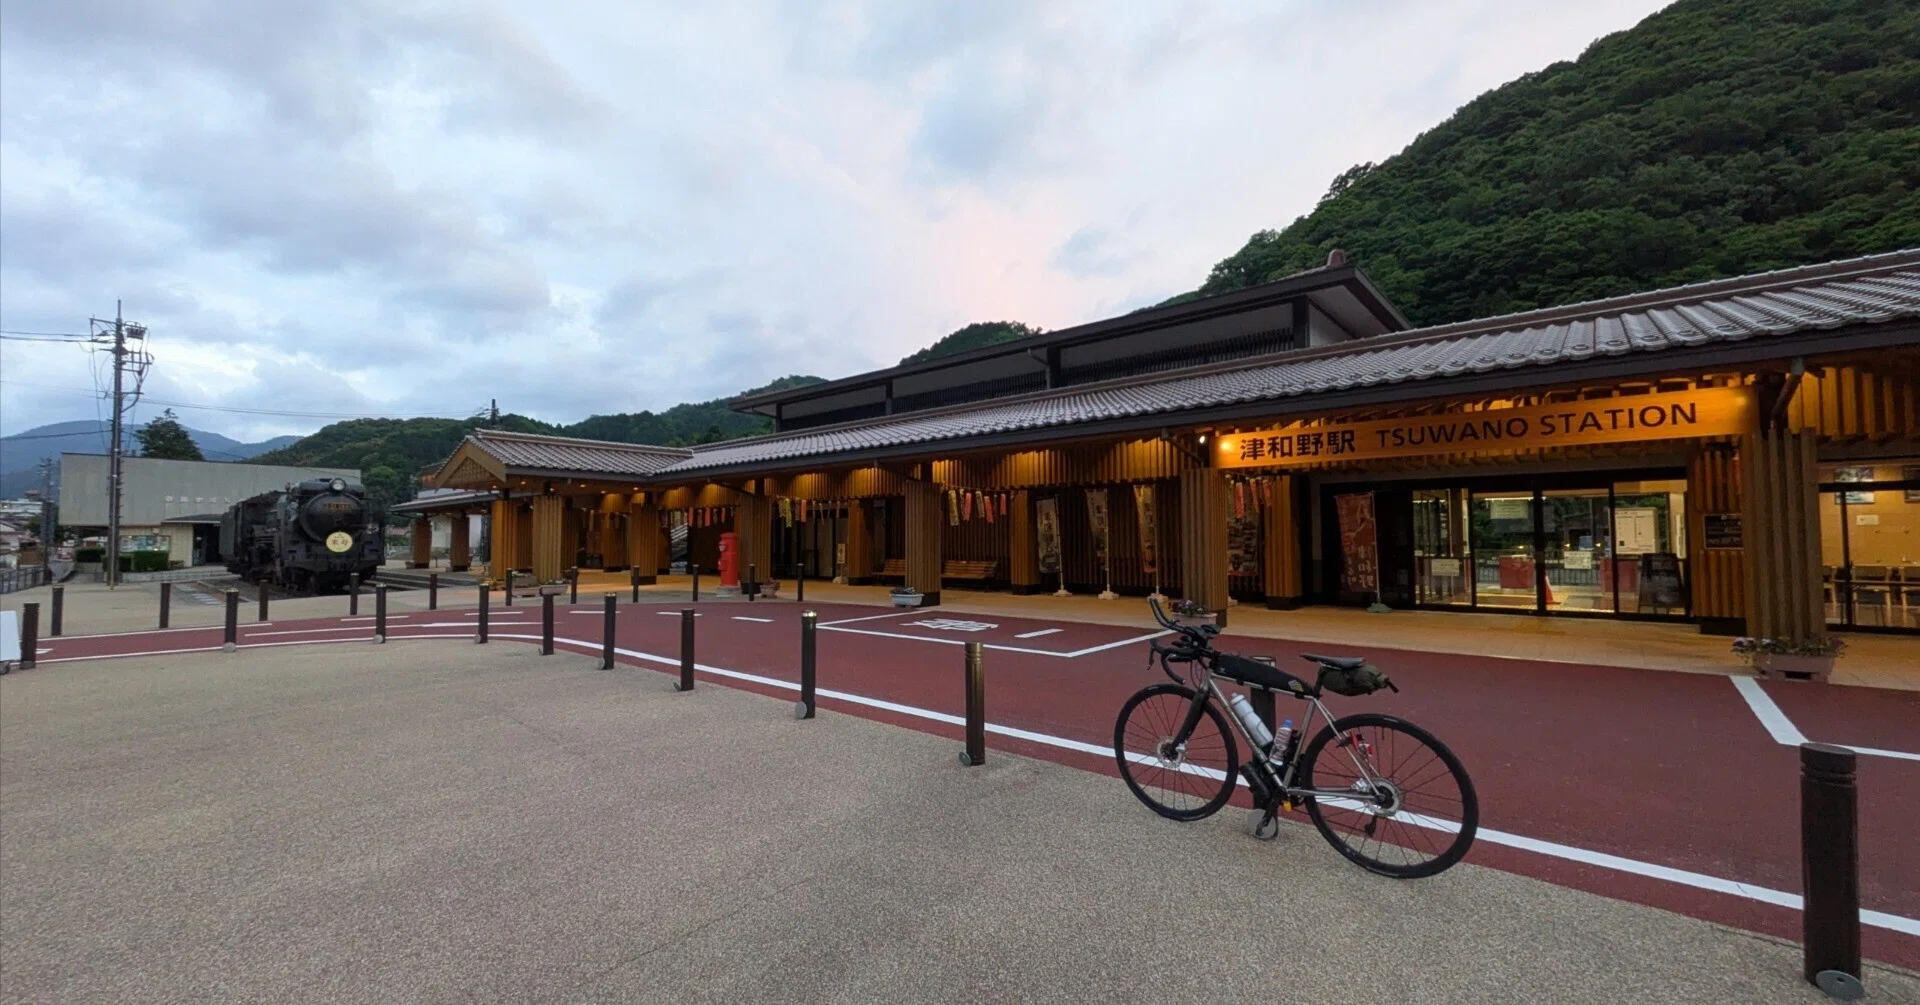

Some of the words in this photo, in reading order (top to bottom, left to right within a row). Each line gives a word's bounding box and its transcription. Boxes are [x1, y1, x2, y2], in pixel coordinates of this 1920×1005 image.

[1240, 429, 1356, 461] 津和野駅
[1376, 417, 1529, 448] TSUWANO
[1540, 402, 1697, 435] STATION
